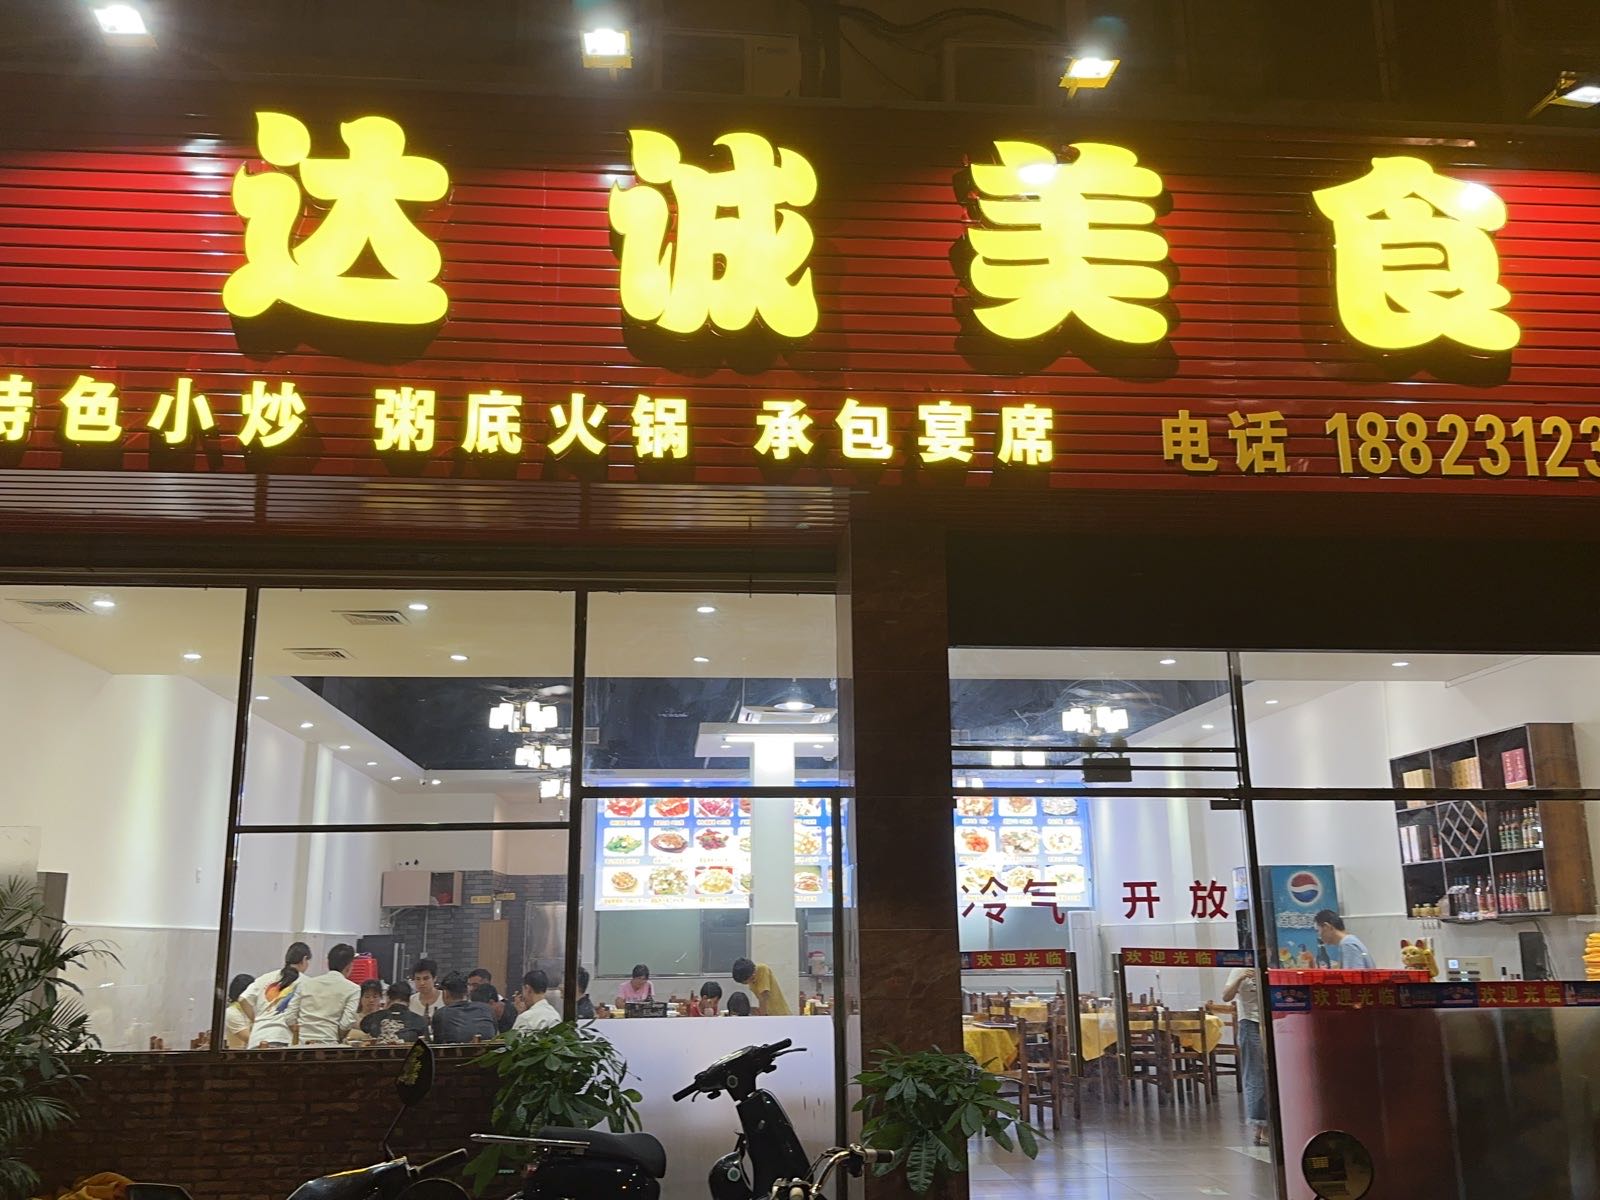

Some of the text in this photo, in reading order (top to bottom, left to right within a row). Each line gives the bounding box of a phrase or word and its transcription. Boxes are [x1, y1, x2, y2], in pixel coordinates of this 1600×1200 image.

[223, 112, 1521, 350] 达诚美食
[374, 387, 688, 459] 粥底火锅
[754, 399, 1054, 466] 承包宴席
[1162, 410, 1289, 474] 电话
[961, 876, 1229, 924] 冷气开放
[976, 951, 1062, 967] 欢迎光临
[1125, 950, 1213, 966] 欢迎光临
[1313, 986, 1396, 1007] 欢迎光临
[1480, 985, 1562, 1004] 欢迎光临
